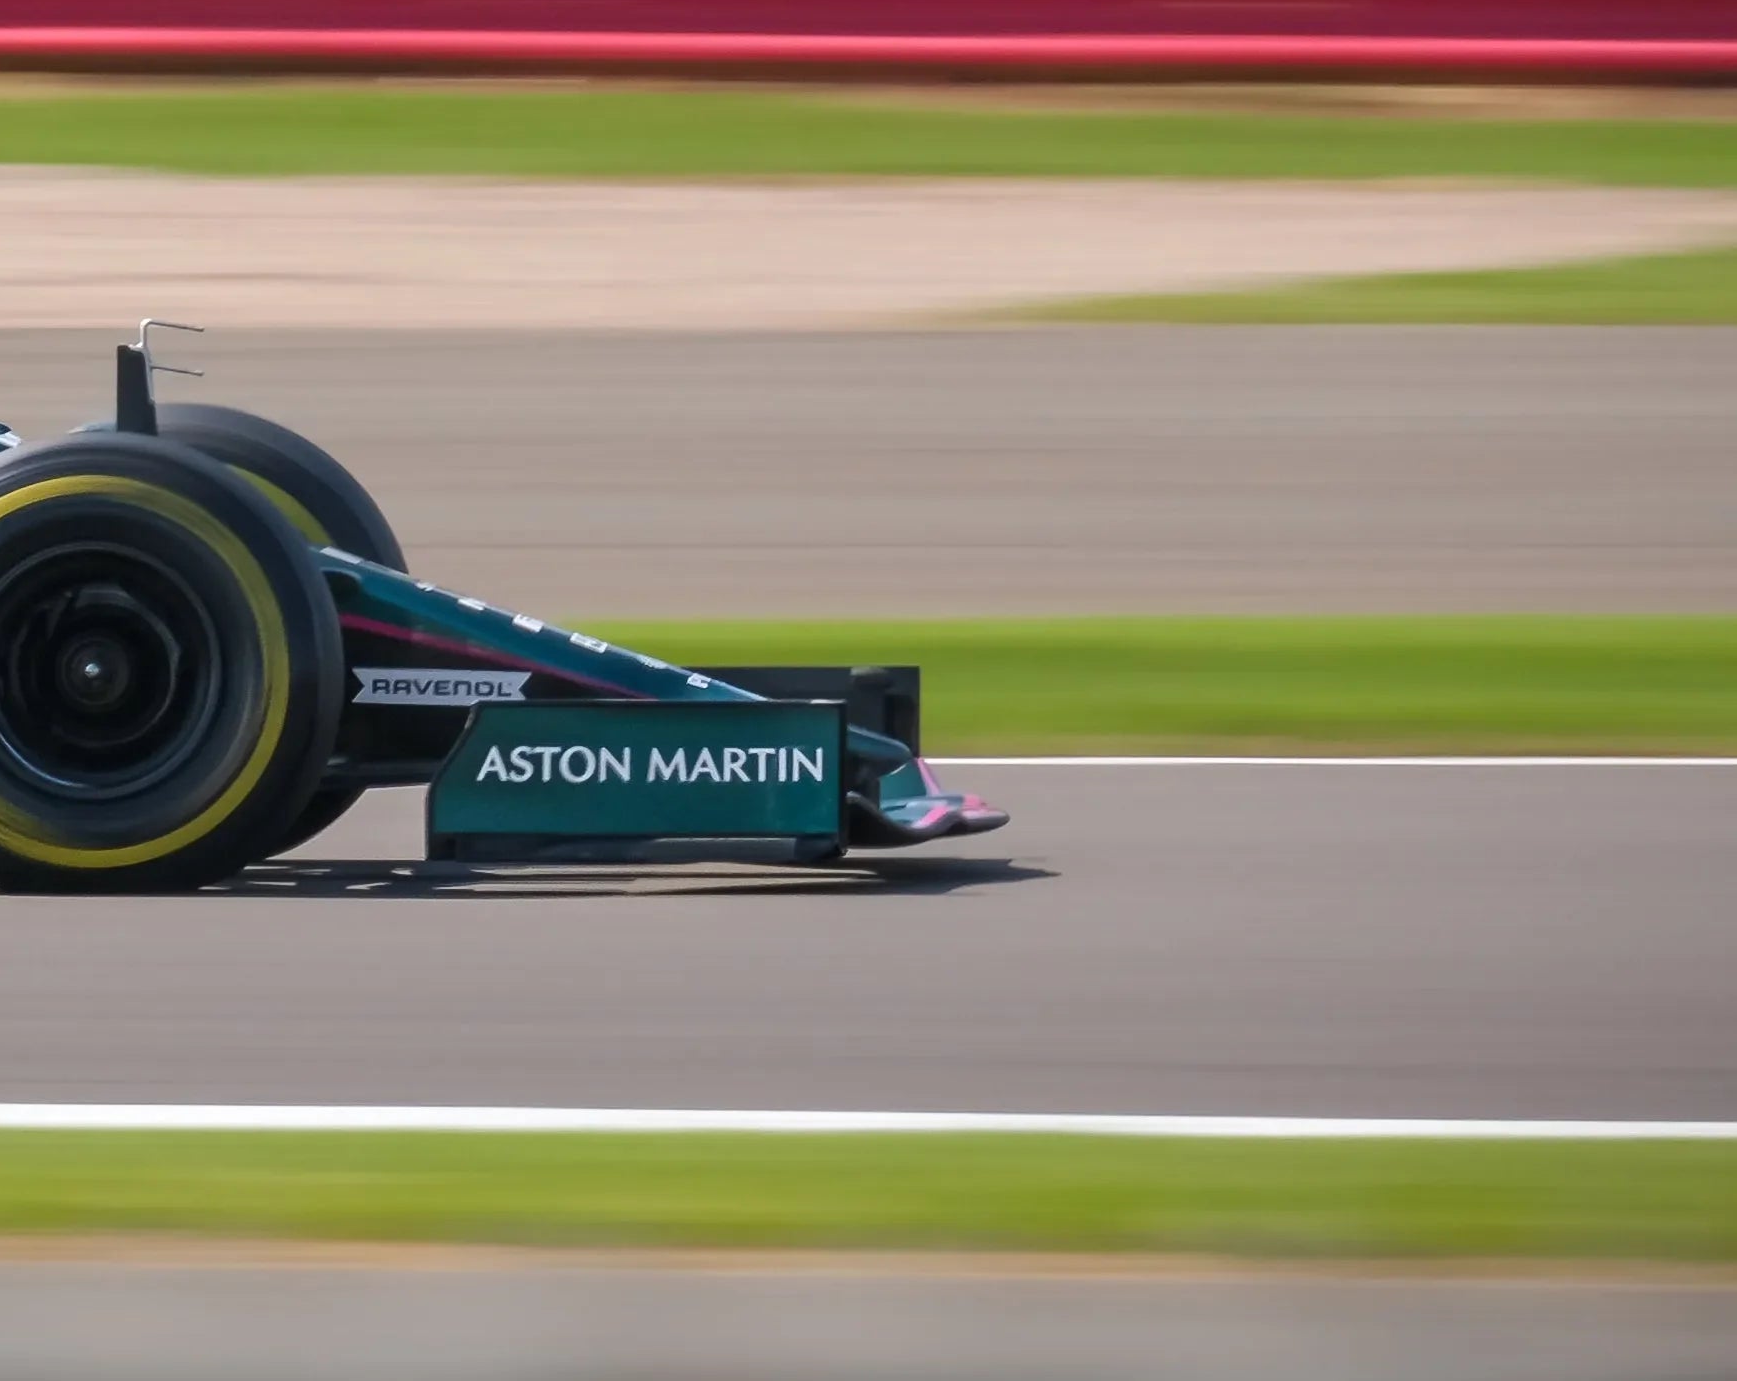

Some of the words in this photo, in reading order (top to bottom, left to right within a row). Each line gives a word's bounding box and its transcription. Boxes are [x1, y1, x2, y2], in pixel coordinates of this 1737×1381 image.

[370, 677, 514, 699] RAVENOL
[475, 744, 631, 784] ASTON
[646, 745, 824, 784] MARTIN
